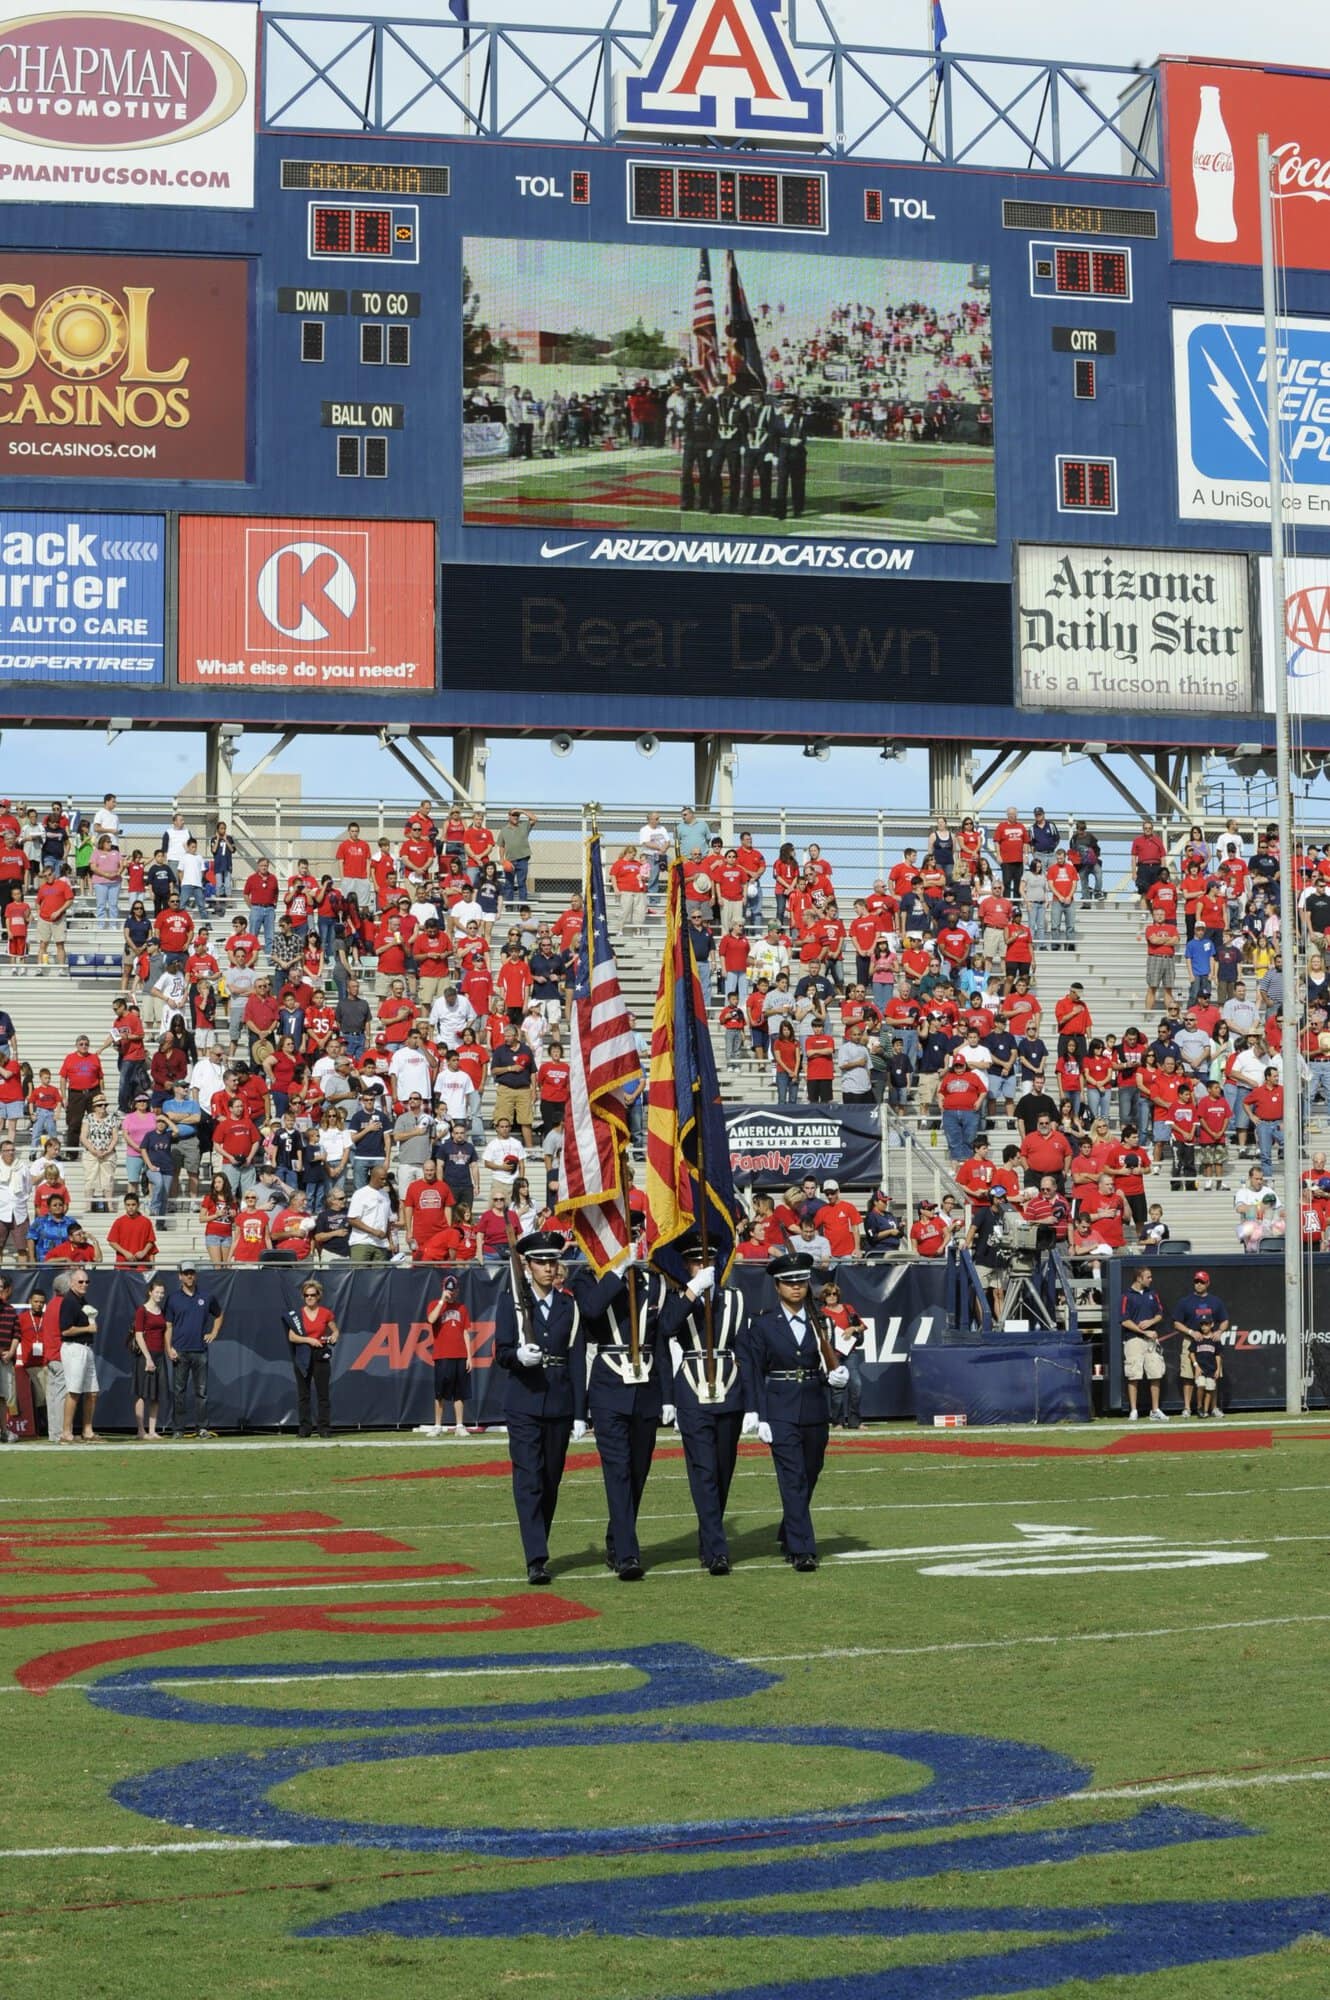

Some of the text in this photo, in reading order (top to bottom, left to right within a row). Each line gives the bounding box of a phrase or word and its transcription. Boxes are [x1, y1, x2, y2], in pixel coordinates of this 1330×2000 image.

[0, 43, 193, 100] CHAPMAN
[0, 96, 188, 120] AUTOMOTIVE
[309, 162, 421, 193] ARIZONA
[515, 175, 564, 198] TOL
[889, 197, 936, 220] TOL
[1052, 207, 1102, 232] WSU
[295, 291, 329, 312] DWN
[362, 293, 408, 315] TO GO
[1071, 330, 1097, 351] QTR
[331, 404, 393, 427] BALL ON
[9, 442, 157, 458] SOLCASINOS.COM
[1192, 489, 1206, 505] A
[1211, 490, 1301, 510] UniSouce
[0, 523, 98, 566] ack
[590, 538, 915, 571] ARIZONAWILDCATS.COM
[1045, 555, 1218, 605] Arizona
[10, 616, 149, 636] AUTO CARE
[521, 596, 941, 676] Bear Down
[1019, 606, 1243, 664] Daily Star
[196, 659, 417, 680] What else do you need?
[1023, 669, 1058, 691] It's
[1066, 676, 1080, 692] a
[1088, 670, 1170, 695] Tucson
[288, 1017, 297, 1035] 7
[312, 1018, 330, 1034] 35
[729, 1125, 840, 1139] AMERICAN FAMILY
[738, 1138, 833, 1147] INSURANCE
[351, 1321, 497, 1370] ARZ
